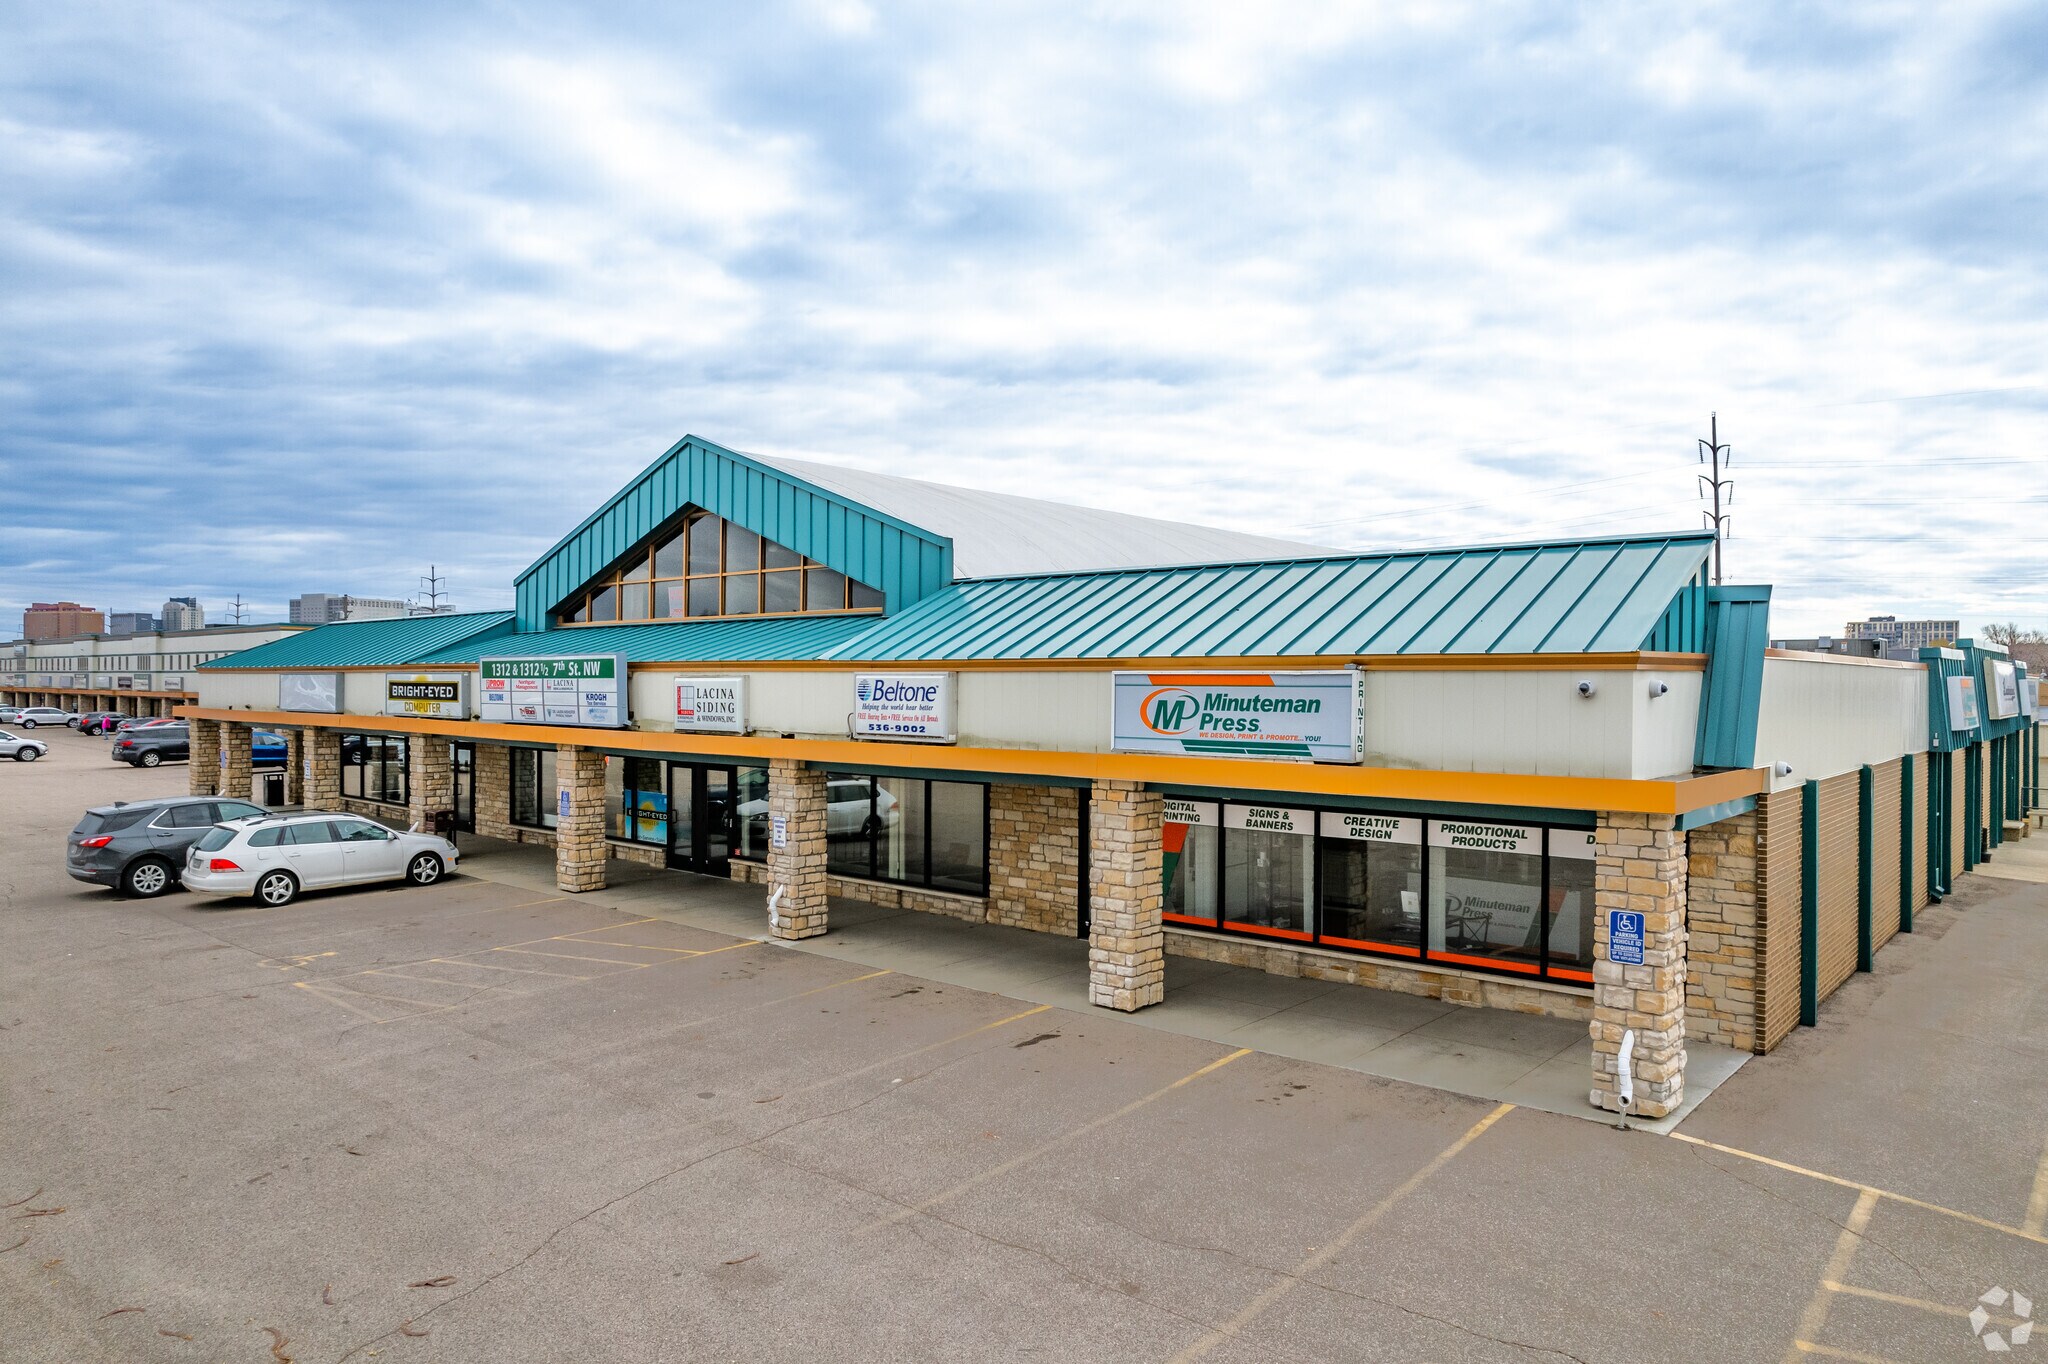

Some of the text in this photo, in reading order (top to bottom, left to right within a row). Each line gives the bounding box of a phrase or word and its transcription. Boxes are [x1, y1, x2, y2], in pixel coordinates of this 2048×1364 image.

[491, 663, 511, 676] 1312
[512, 663, 519, 676] &
[552, 660, 565, 676] 7th
[568, 661, 581, 676] St.
[583, 661, 601, 676] NW
[696, 688, 735, 700] LACINA
[872, 679, 937, 702] Beltone
[586, 693, 607, 701] KROGH
[1203, 693, 1321, 713] Minuteman
[404, 701, 441, 713] COMPUTER
[696, 701, 735, 714] SIDING
[861, 703, 880, 711] Helping
[726, 715, 736, 723] INC.
[1198, 713, 1261, 732] Press
[868, 723, 926, 733] 536-9002
[1210, 732, 1236, 740] DESIGN,
[1164, 811, 1201, 823] RINTING
[1248, 808, 1290, 820] SIGNS &
[1245, 818, 1294, 831] BANNERS
[1343, 816, 1400, 829] CREATIVE
[1349, 827, 1393, 840] DESIGN
[1440, 823, 1529, 840] PROMOTIONAL
[1451, 836, 1517, 851] PRODUCTS
[1464, 896, 1530, 914] Minuteman
[1462, 906, 1494, 920] Press
[1615, 931, 1639, 939] PARKING
[1612, 938, 1634, 946] VEHICLE
[1613, 944, 1640, 953] REQUIRED
